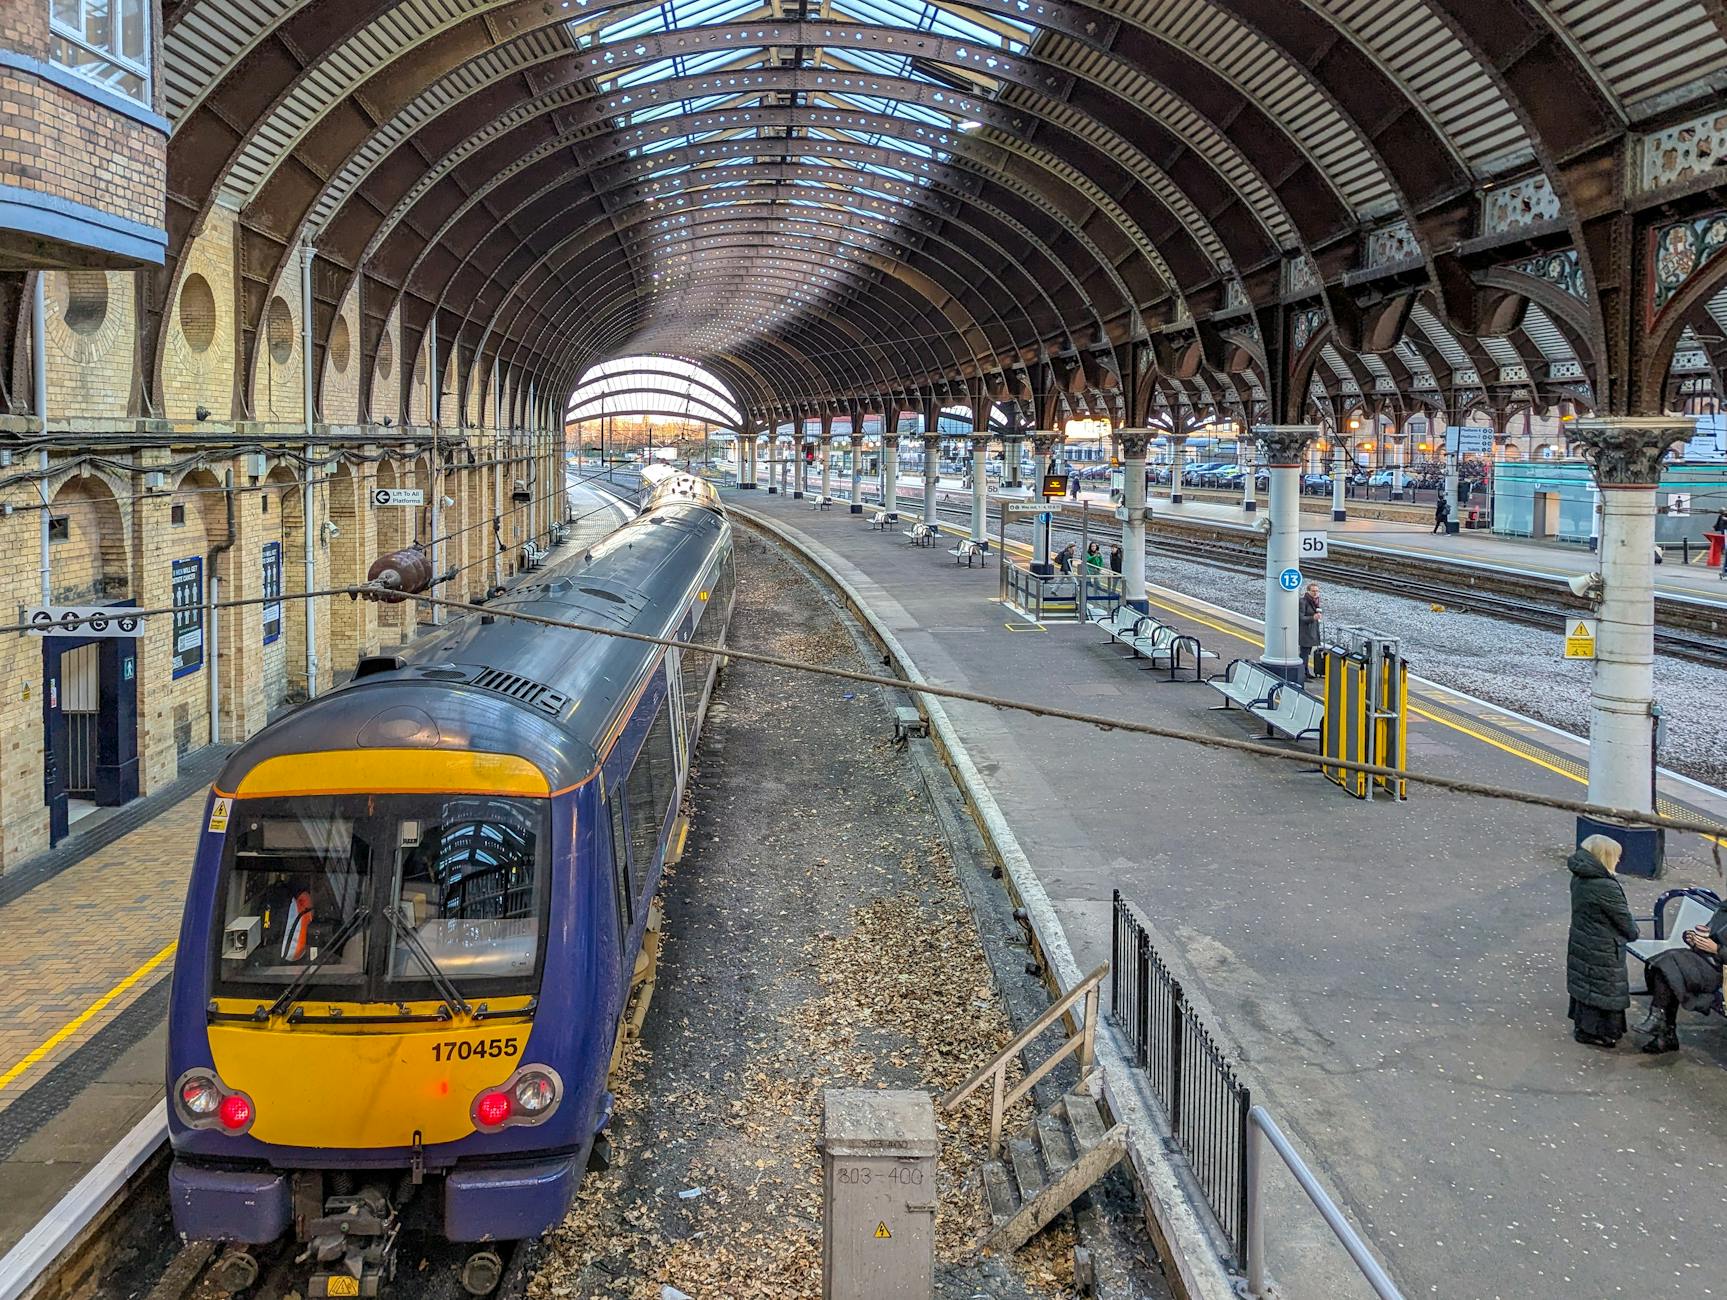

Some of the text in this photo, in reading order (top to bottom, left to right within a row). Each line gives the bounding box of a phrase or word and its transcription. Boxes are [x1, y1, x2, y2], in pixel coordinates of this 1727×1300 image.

[1302, 538, 1324, 551] 5b
[1284, 575, 1298, 586] 13
[432, 1038, 518, 1061] 170455
